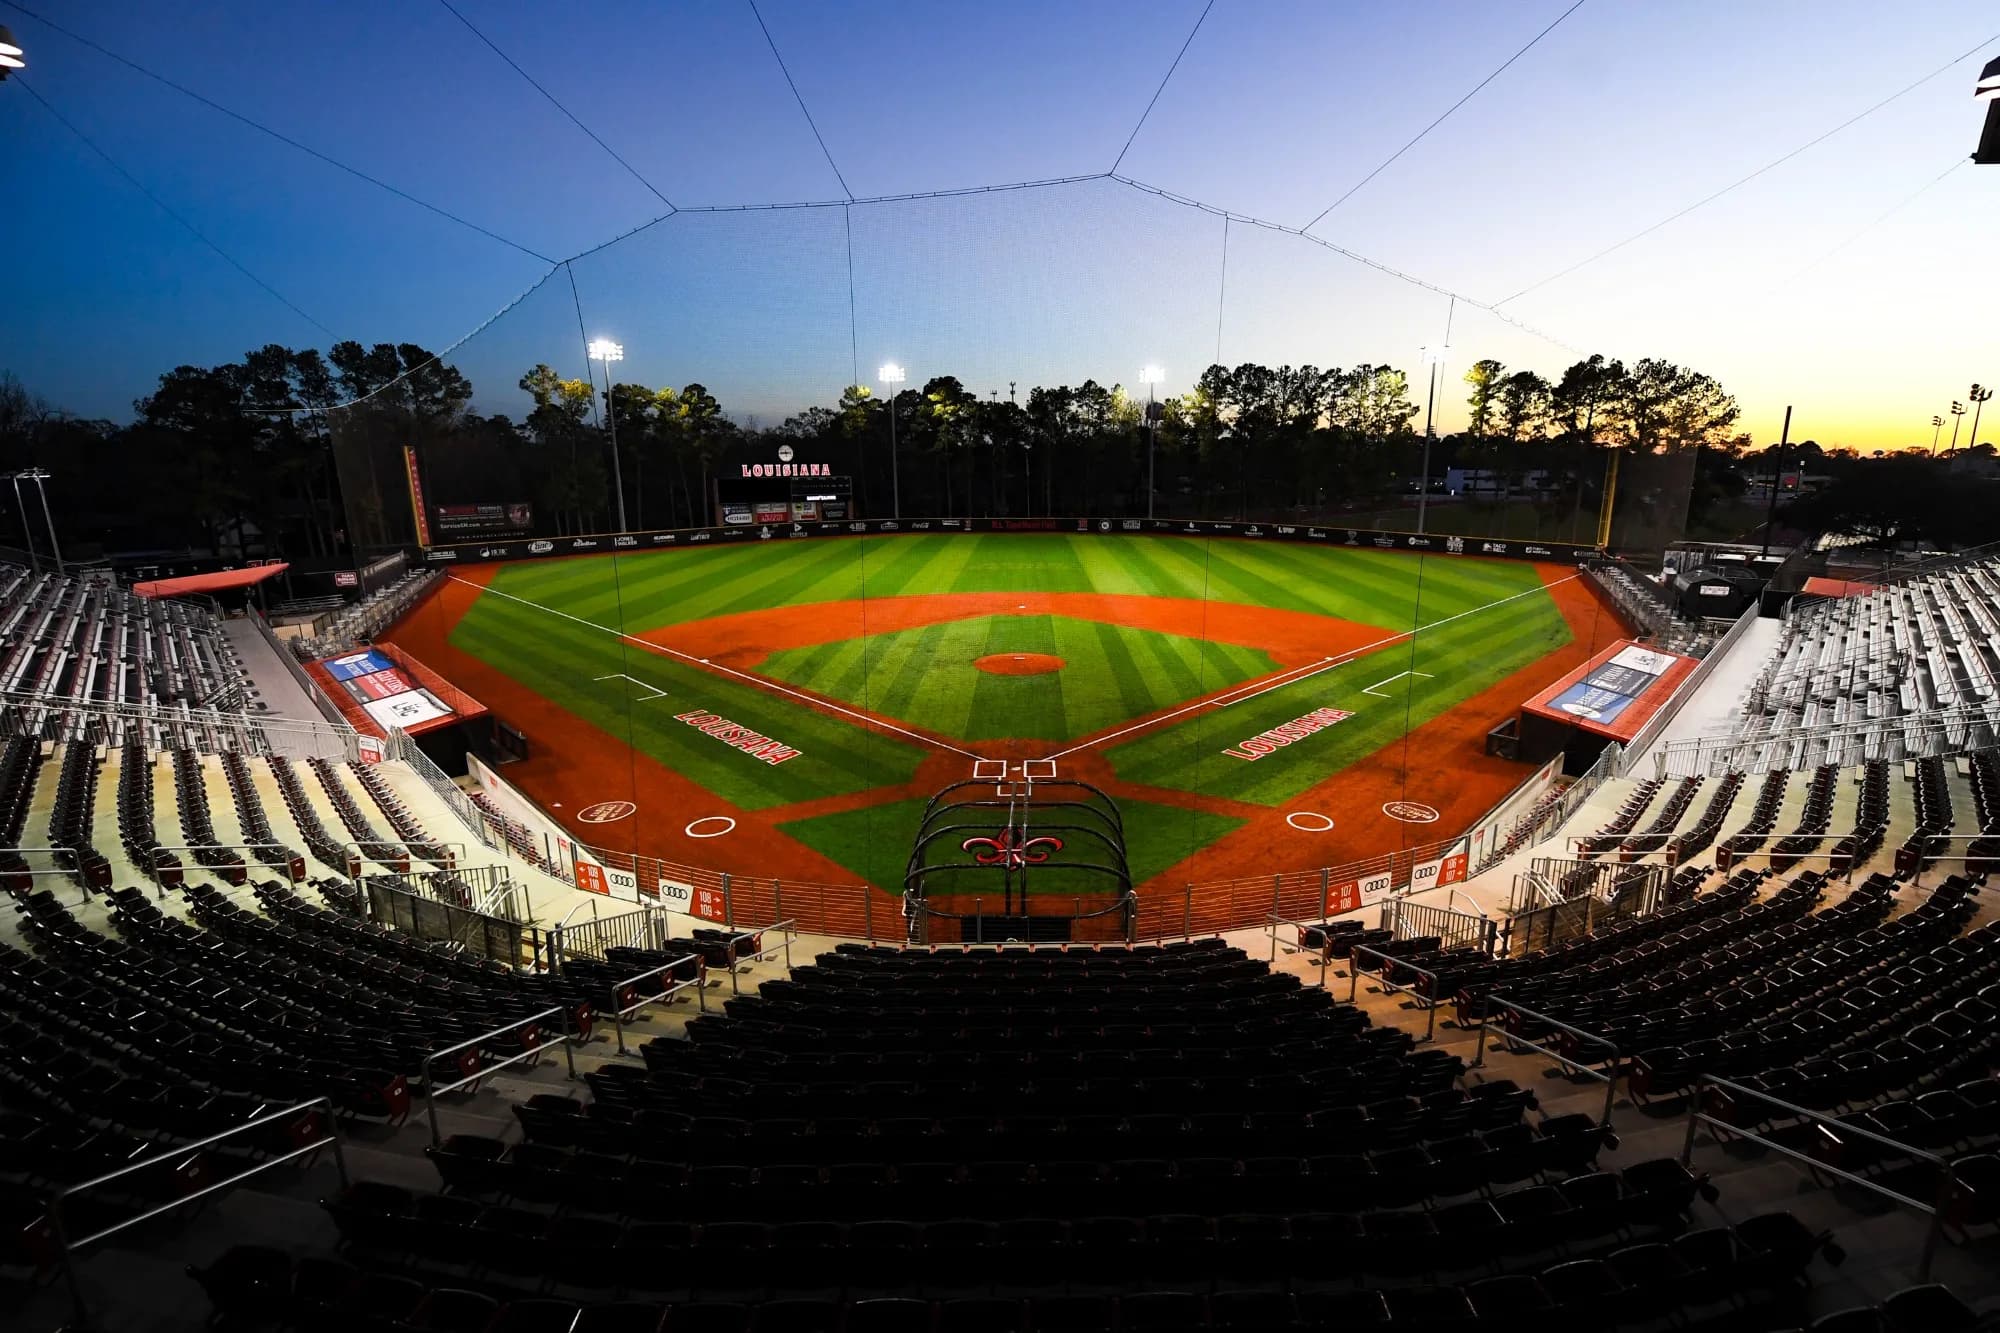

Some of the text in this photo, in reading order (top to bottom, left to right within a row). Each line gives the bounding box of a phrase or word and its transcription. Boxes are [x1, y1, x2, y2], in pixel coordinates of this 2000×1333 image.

[741, 463, 832, 477] LOUISIANA
[673, 709, 803, 765] LOUISIANA
[1220, 707, 1356, 761] LOUISIANA
[699, 891, 711, 904] 108
[1340, 884, 1352, 897] 107
[700, 903, 712, 917] 109
[1340, 897, 1352, 910] 108
